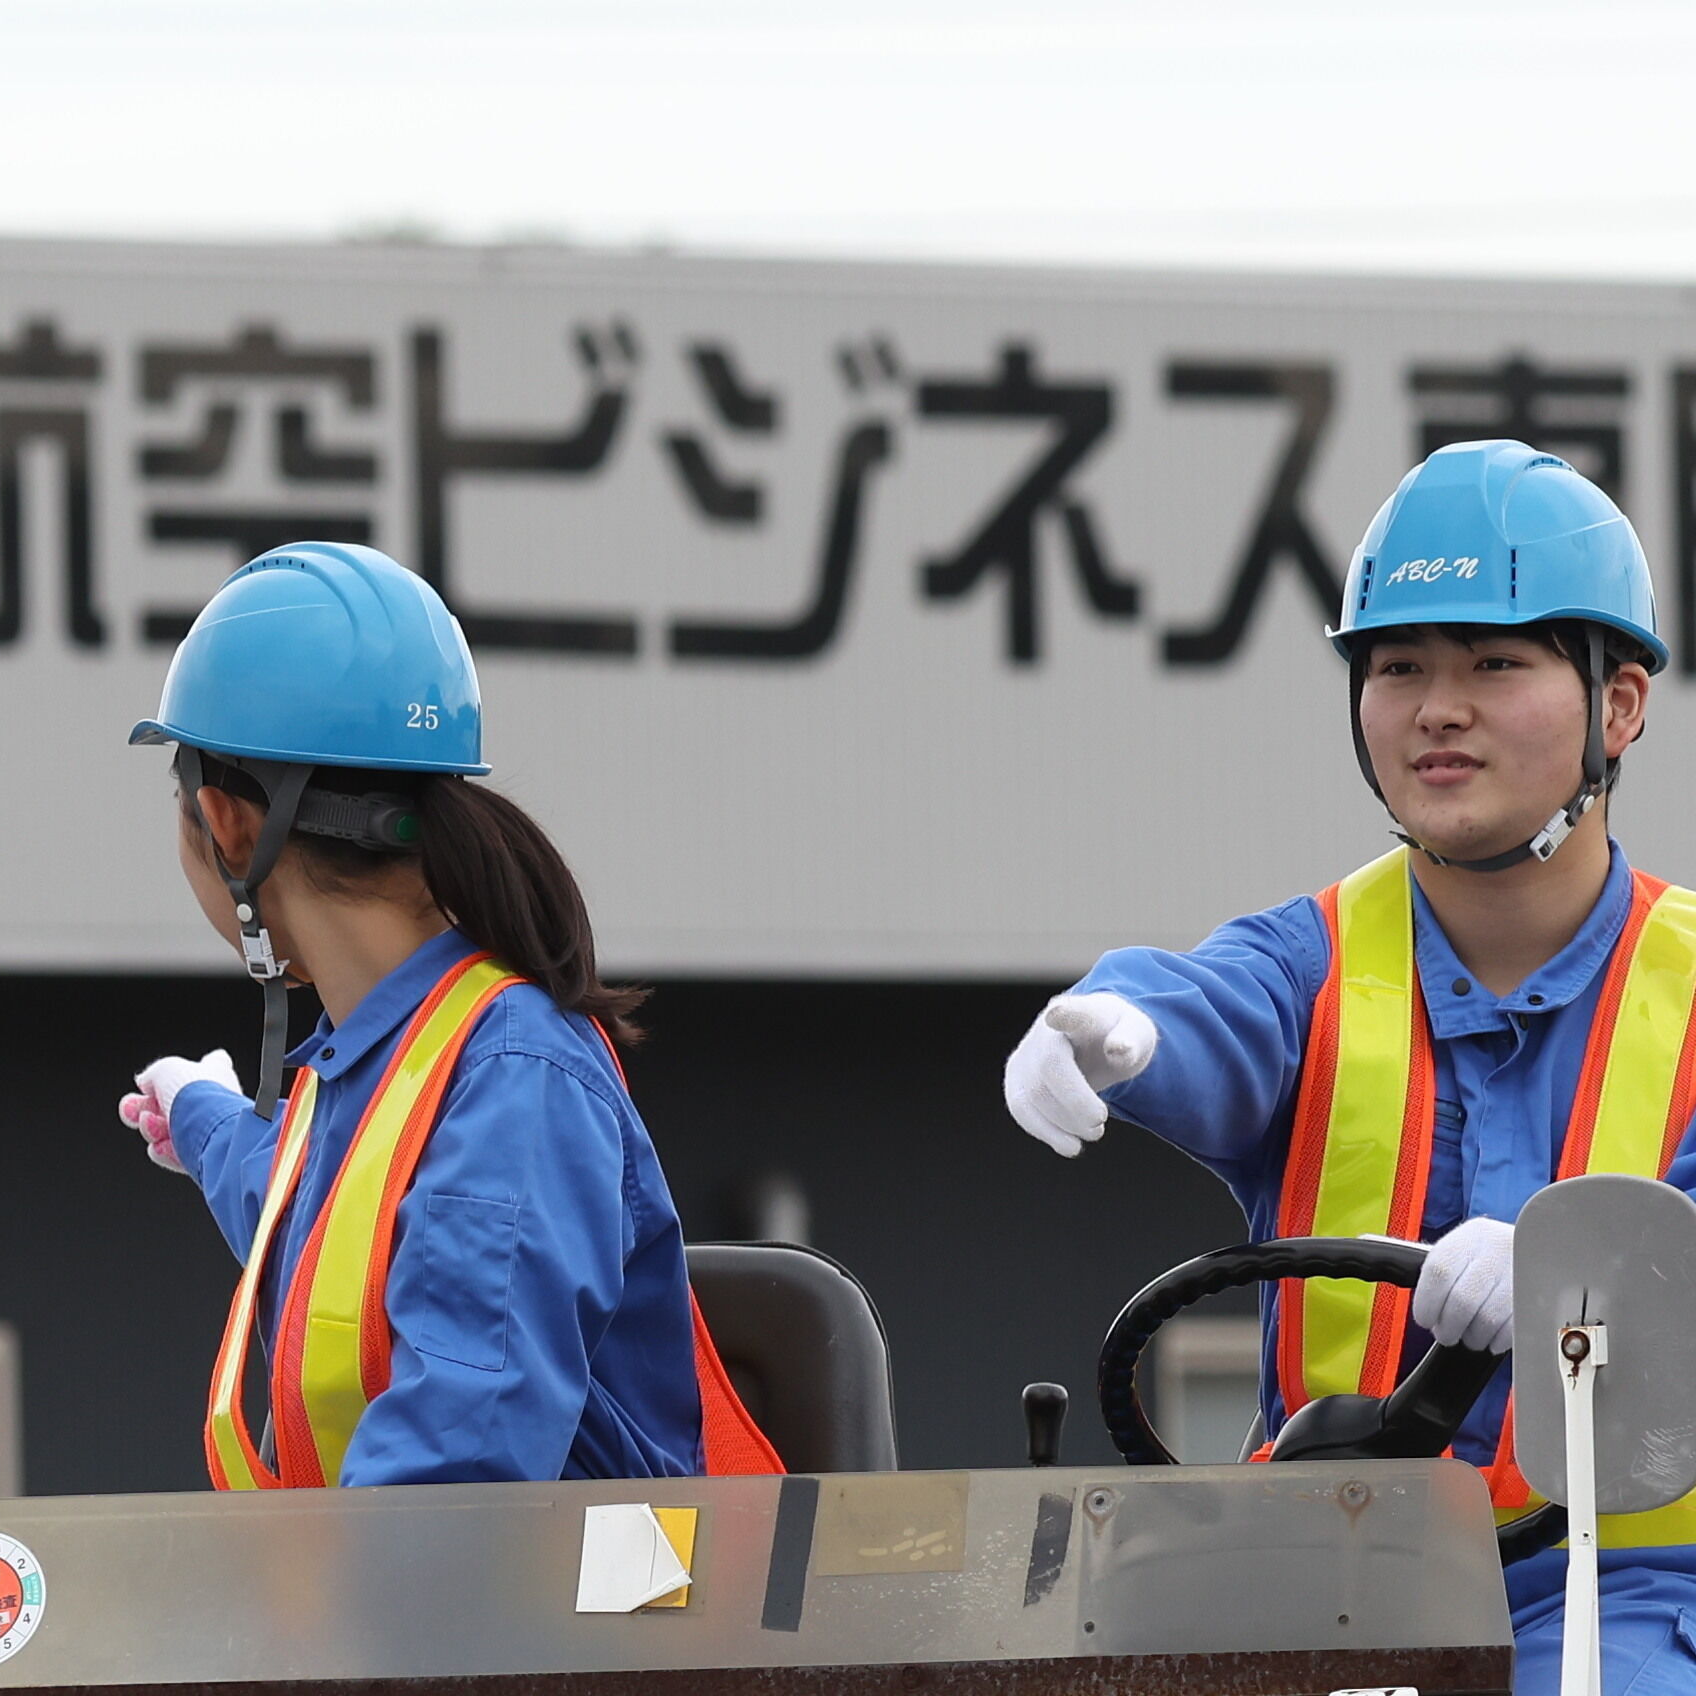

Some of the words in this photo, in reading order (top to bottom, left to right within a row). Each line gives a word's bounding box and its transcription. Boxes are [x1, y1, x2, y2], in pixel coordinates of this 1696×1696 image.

[1386, 557, 1480, 586] ABC-N
[406, 702, 439, 731] 25
[17, 1558, 26, 1570] 2
[23, 1613, 31, 1624] 4
[4, 1638, 12, 1649] 5
